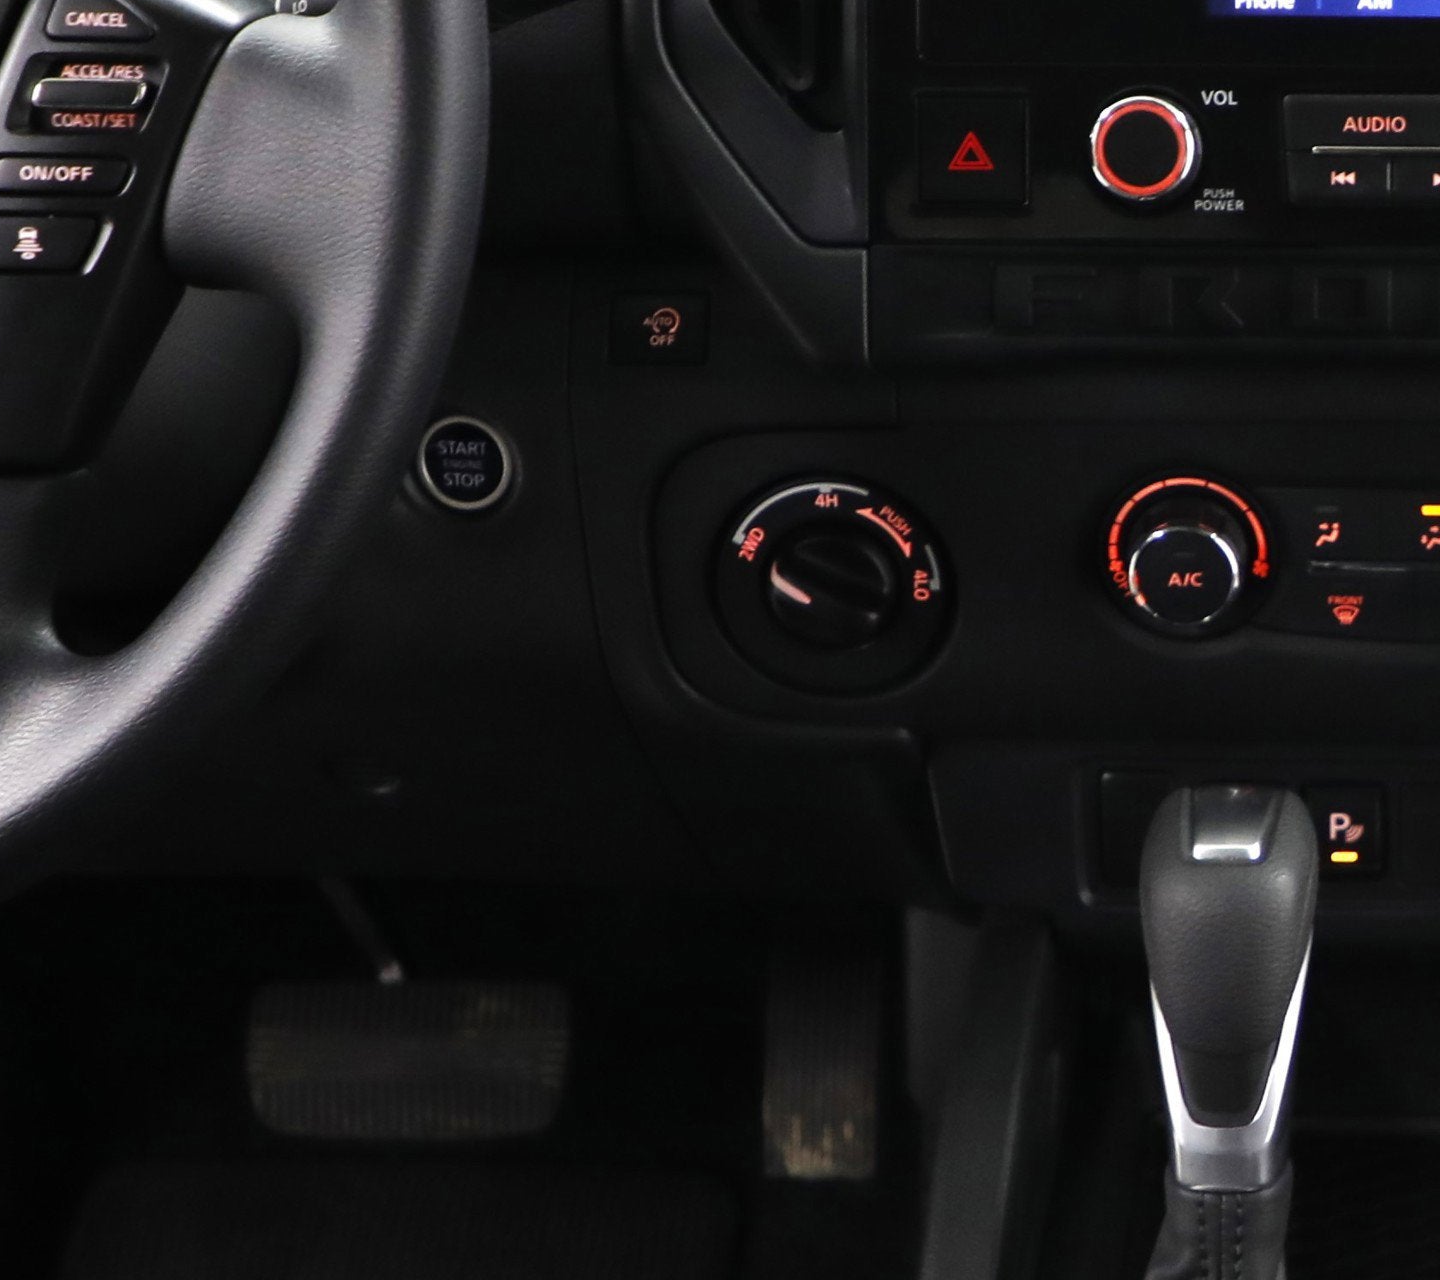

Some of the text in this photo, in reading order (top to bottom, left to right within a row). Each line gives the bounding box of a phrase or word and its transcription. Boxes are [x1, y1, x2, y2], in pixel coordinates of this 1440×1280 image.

[65, 11, 127, 28] CANCEL
[61, 63, 145, 80] ACCEL/RES
[1201, 90, 1238, 106] VOL
[51, 113, 137, 129] COAST/SET
[1343, 116, 1406, 133] AUDIO
[19, 165, 94, 182] ON/OFF
[1203, 189, 1235, 199] PUSH
[1194, 200, 1245, 211] POWER
[650, 335, 674, 346] OFF
[437, 440, 486, 455] START
[443, 472, 485, 487] STOP
[814, 494, 840, 508] 4H
[879, 505, 914, 536] PUSH
[738, 526, 765, 562] 2WD
[913, 569, 931, 601] 4LO
[1168, 572, 1203, 587] A/C
